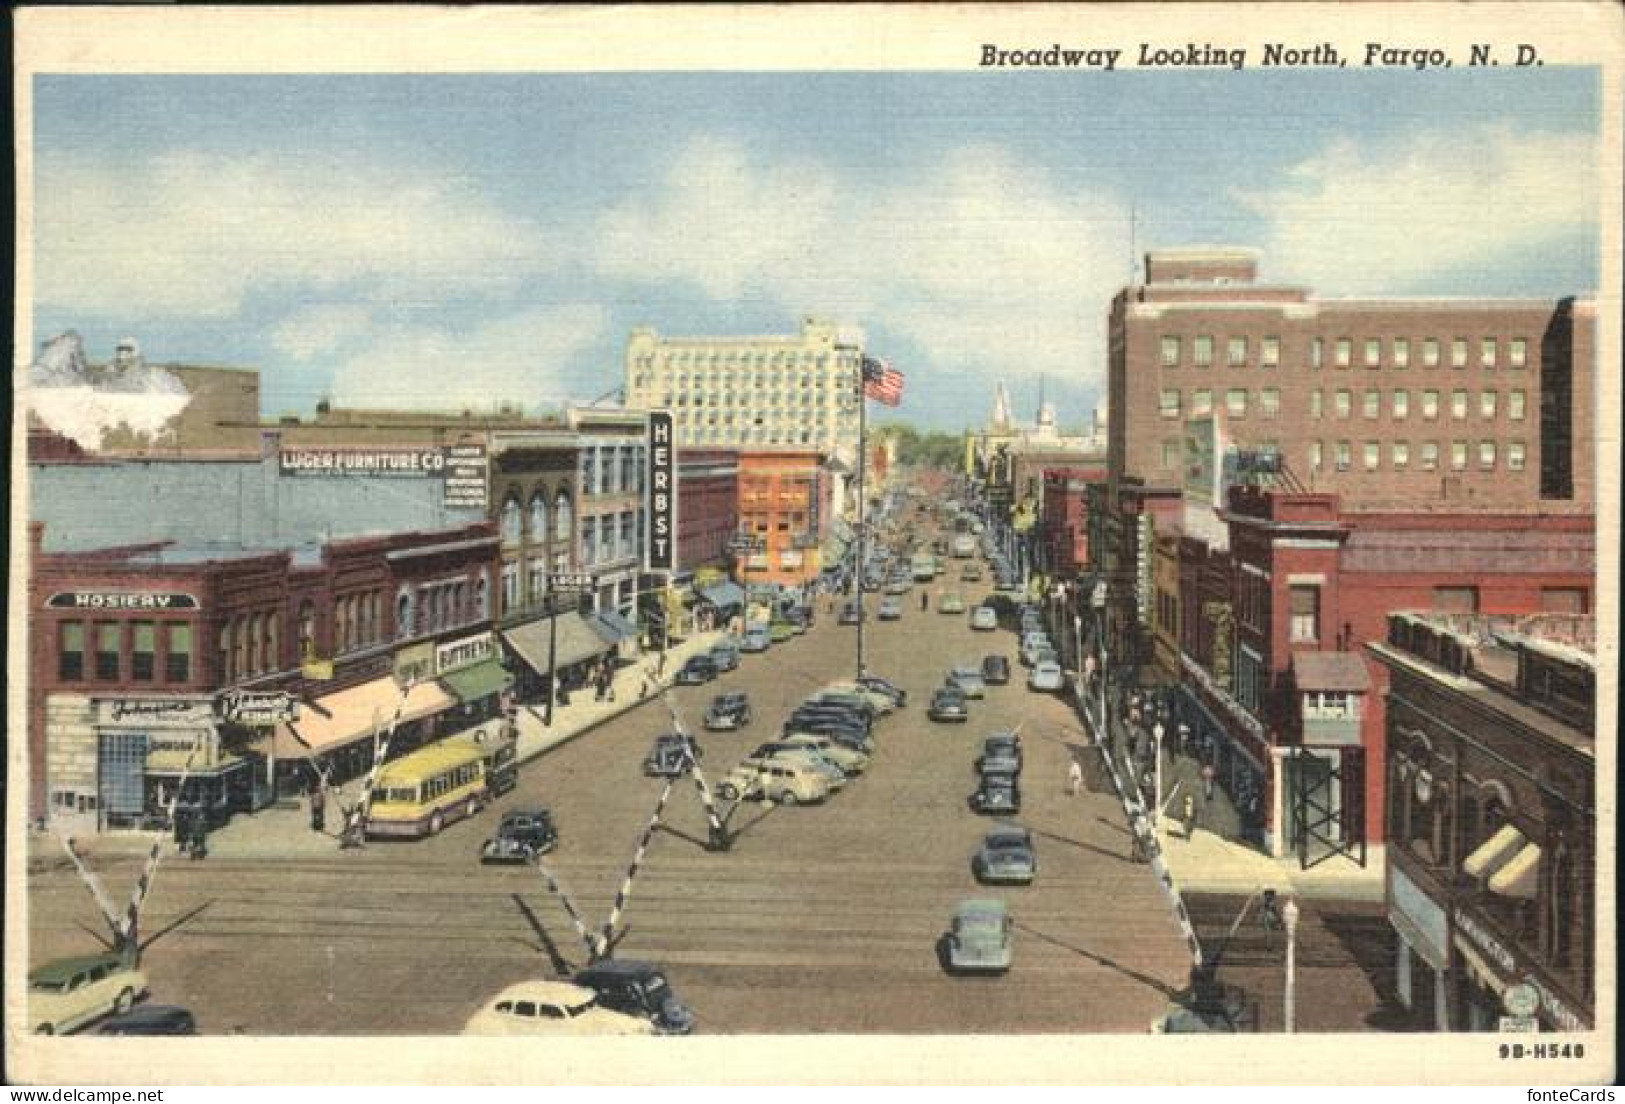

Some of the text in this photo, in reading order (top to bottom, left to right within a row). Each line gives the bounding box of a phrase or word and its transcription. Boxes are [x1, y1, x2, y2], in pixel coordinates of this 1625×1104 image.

[979, 44, 1545, 70] Broadway Looking North, Fargo, N. D.
[655, 423, 668, 558] HERBST
[76, 593, 171, 607] HOSIERY
